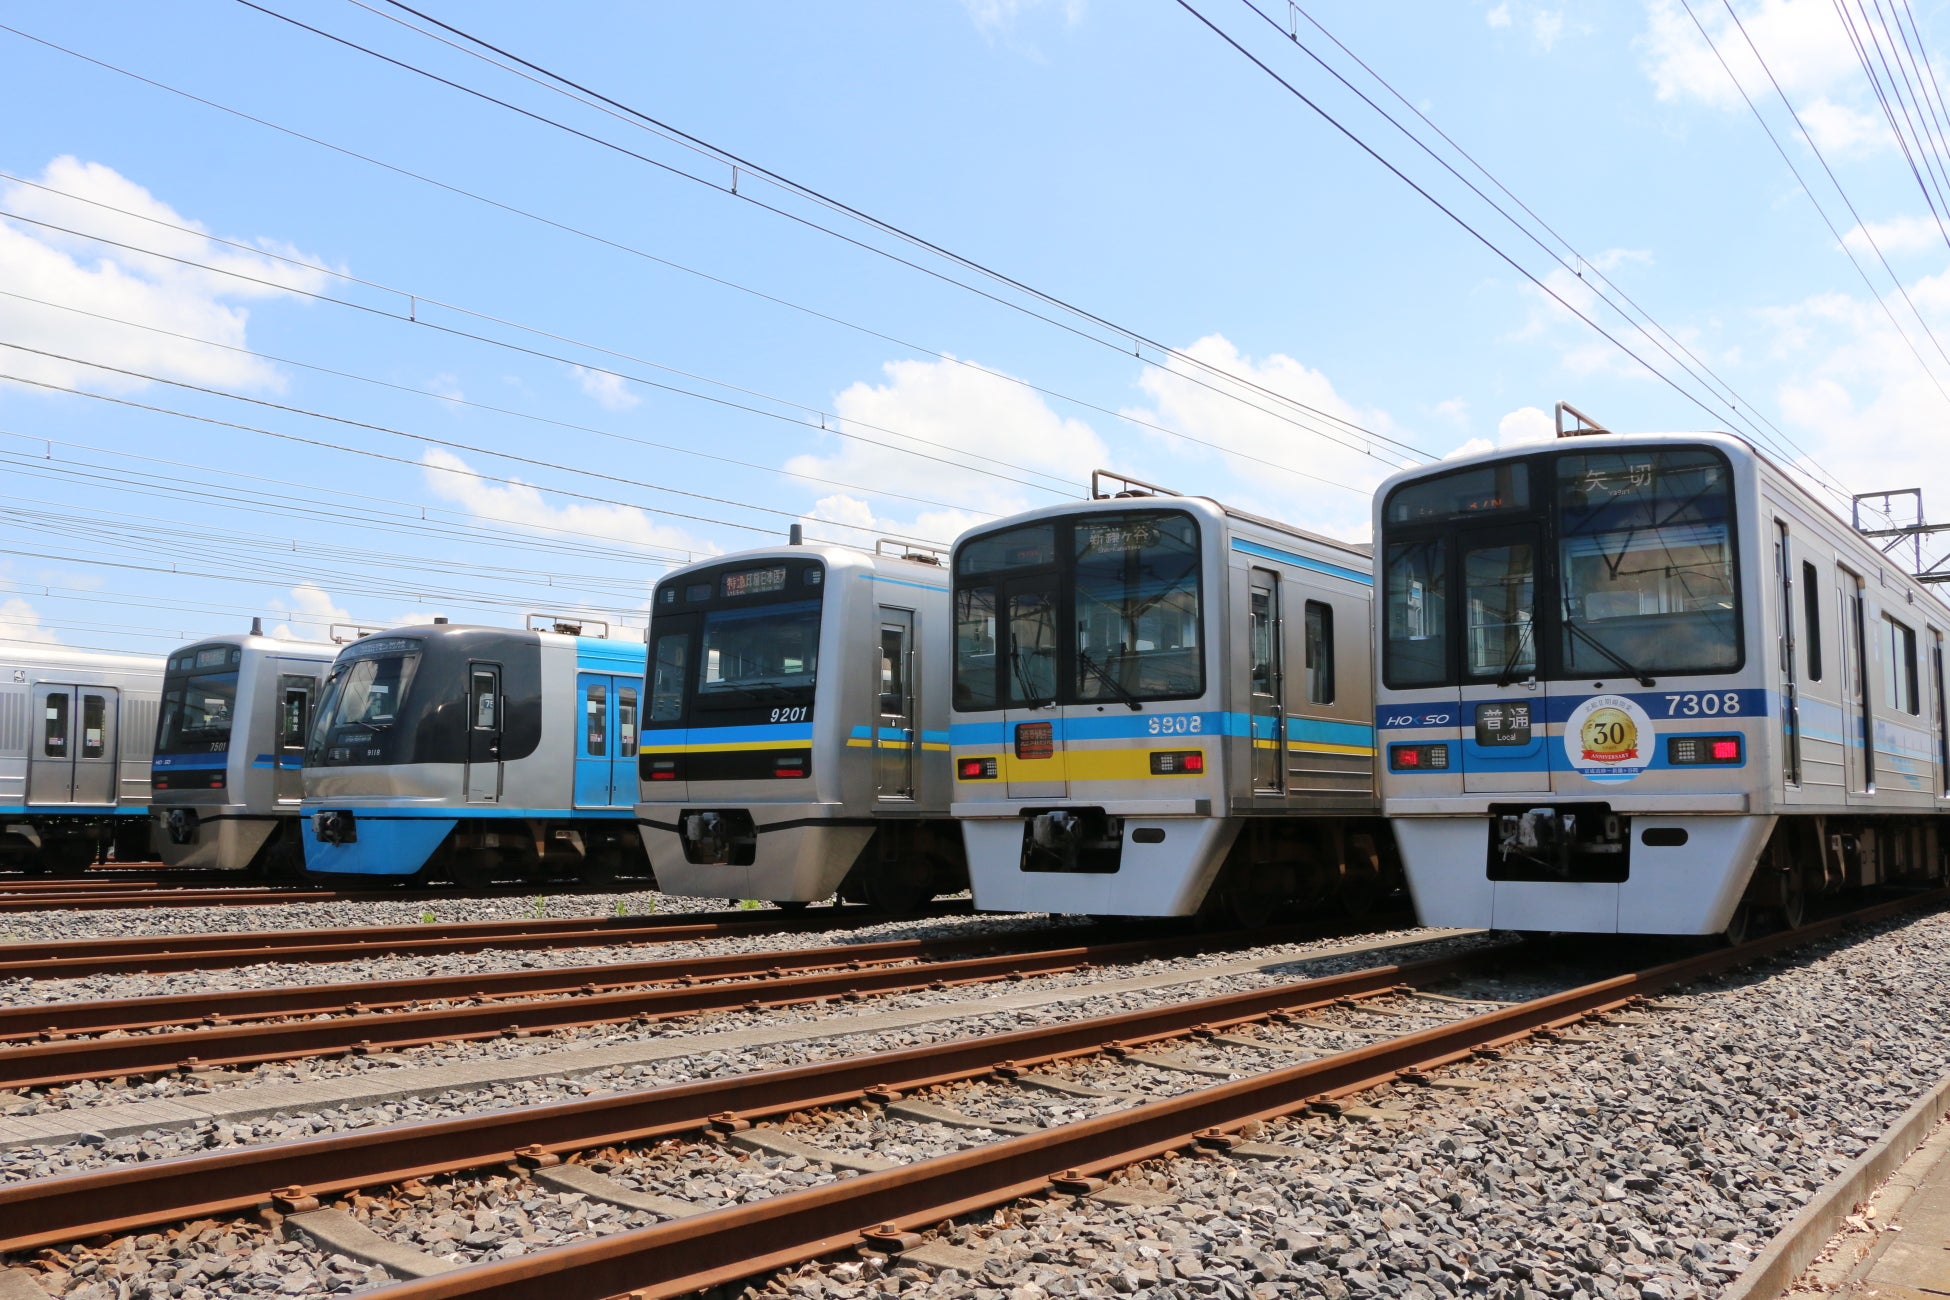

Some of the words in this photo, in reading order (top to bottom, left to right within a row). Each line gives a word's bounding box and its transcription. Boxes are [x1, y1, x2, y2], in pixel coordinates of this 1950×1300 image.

[1585, 464, 1651, 491] 矢切
[1665, 693, 1741, 716] 7308
[770, 706, 807, 723] 9201
[1483, 707, 1530, 730] 普通
[1149, 715, 1201, 734] 9808
[1593, 722, 1625, 745] 30
[1496, 732, 1517, 742] Local
[210, 742, 227, 752] 7501
[1591, 752, 1630, 760] ANNIVERSARY
